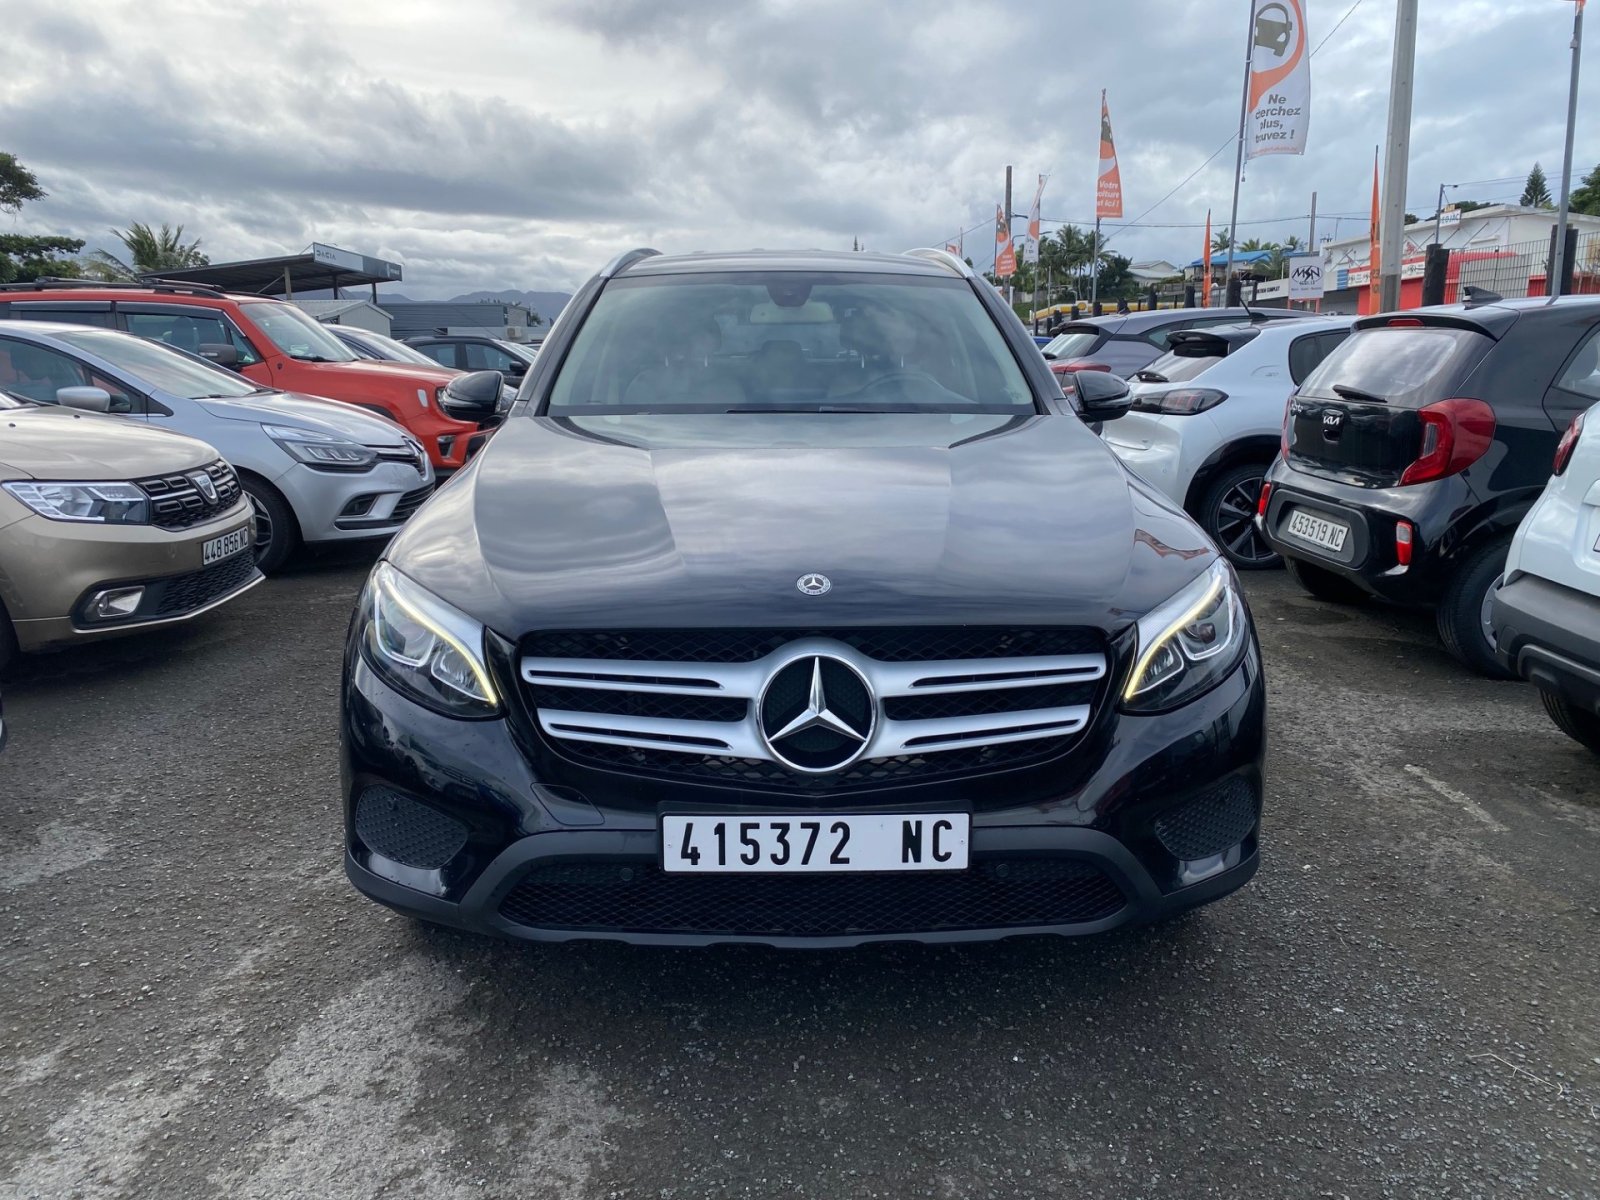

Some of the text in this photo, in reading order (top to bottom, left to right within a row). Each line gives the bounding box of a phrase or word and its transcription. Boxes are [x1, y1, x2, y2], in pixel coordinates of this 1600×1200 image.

[1268, 94, 1287, 104] Ne
[1255, 106, 1301, 119] cerchez
[1290, 129, 1295, 139] !
[1291, 265, 1320, 281] MSN
[1323, 415, 1340, 425] KIA
[1291, 514, 1344, 547] 453519 NC
[204, 528, 249, 561] 448 856 NC
[680, 819, 953, 865] 415372 NC
